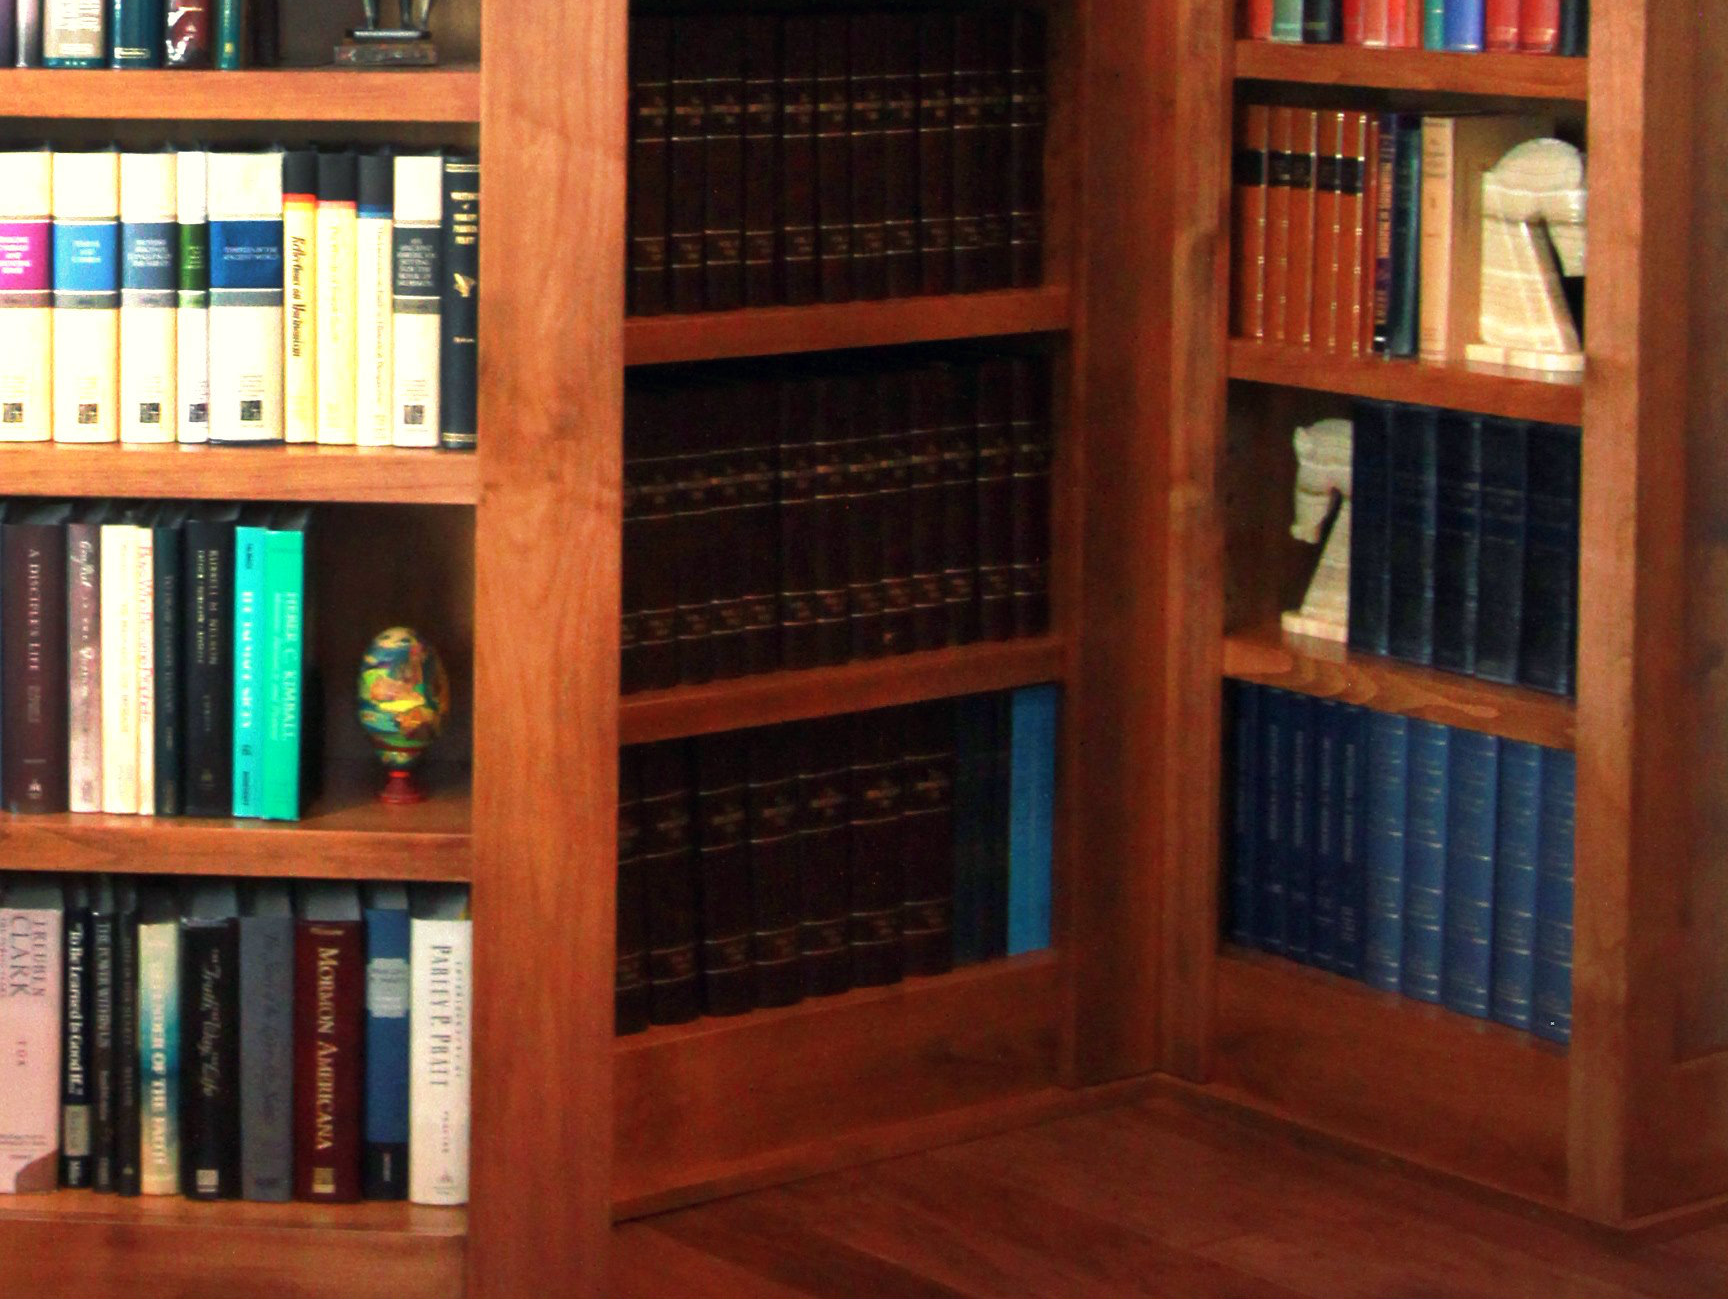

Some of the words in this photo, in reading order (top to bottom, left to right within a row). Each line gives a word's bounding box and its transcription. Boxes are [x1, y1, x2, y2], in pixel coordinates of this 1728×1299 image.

[28, 549, 40, 558] A
[28, 643, 40, 672] LIFE
[10, 916, 31, 999] CLARK
[68, 948, 84, 963] Be
[68, 966, 84, 1020] Learned
[315, 947, 339, 1034] MORMON
[429, 945, 452, 1011] PARLEY
[429, 1016, 452, 1027] P.
[68, 1035, 84, 1069] Good
[150, 1053, 167, 1075] OF
[429, 1033, 452, 1088] PRATT
[150, 1079, 167, 1110] THE
[315, 1040, 339, 1149] AMERICANA
[150, 1116, 167, 1166] FAITH
